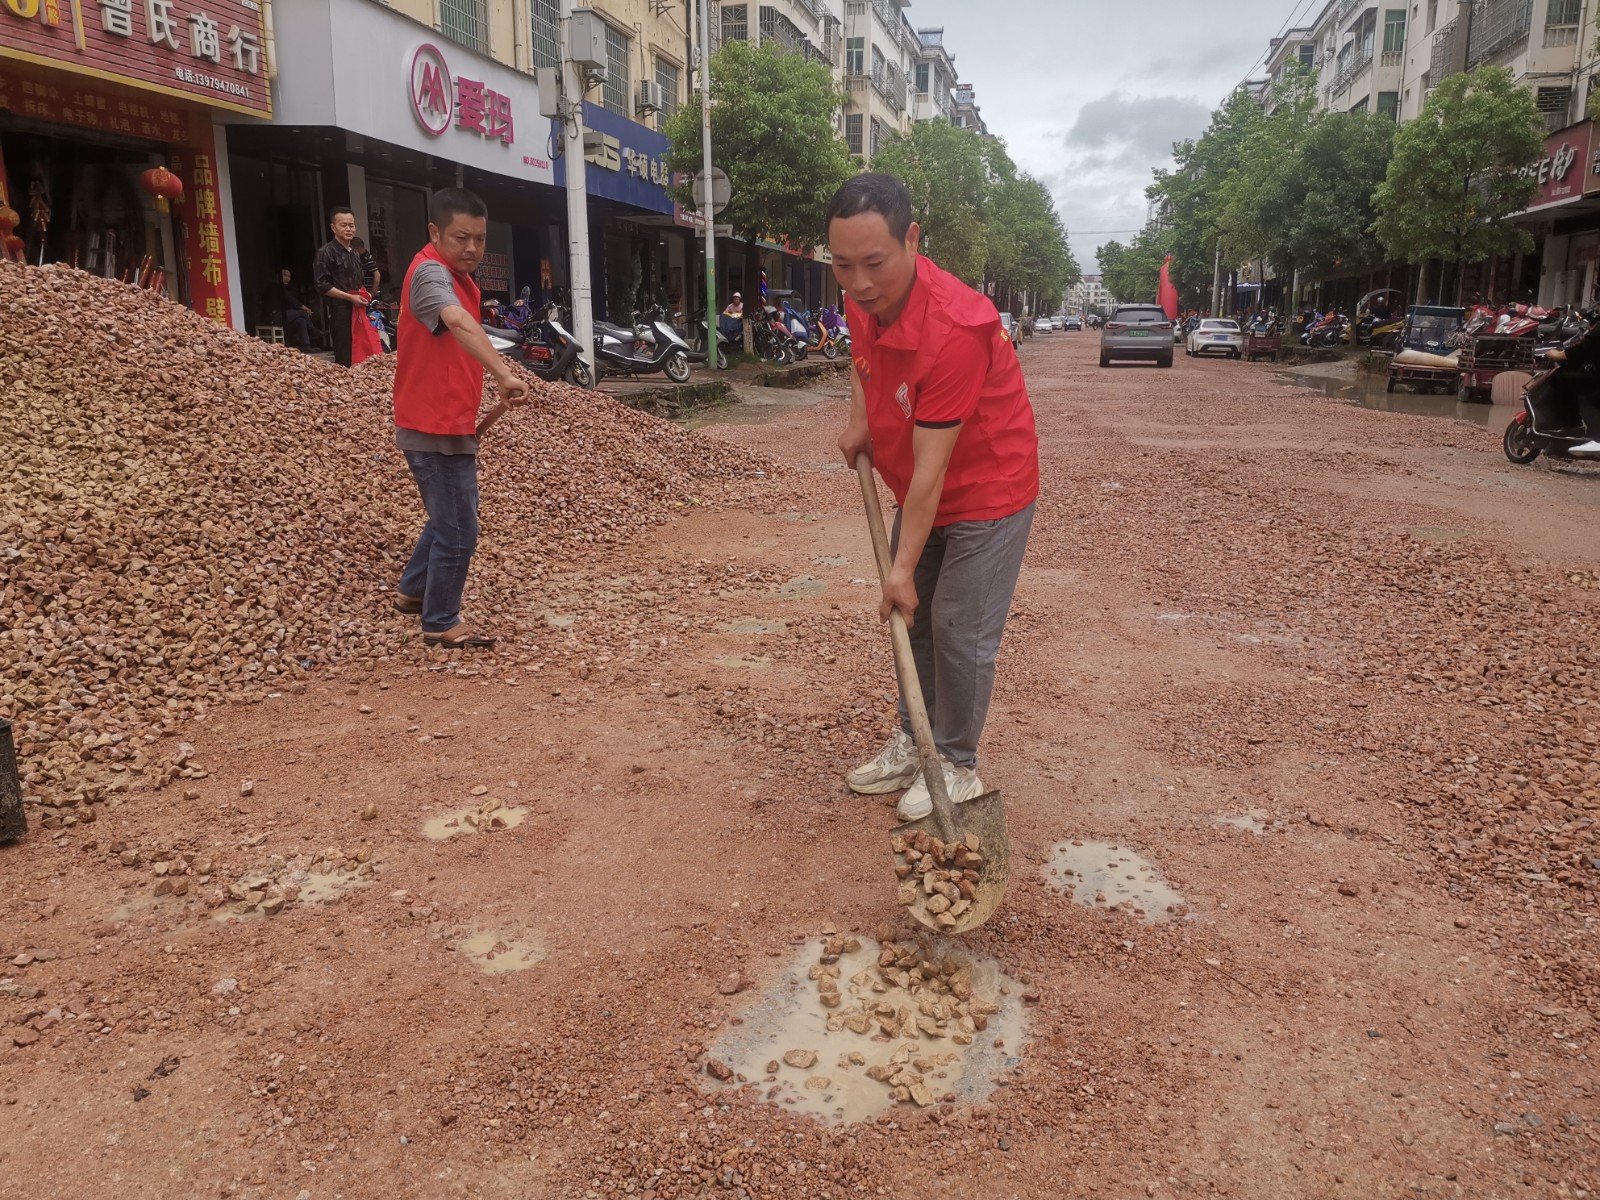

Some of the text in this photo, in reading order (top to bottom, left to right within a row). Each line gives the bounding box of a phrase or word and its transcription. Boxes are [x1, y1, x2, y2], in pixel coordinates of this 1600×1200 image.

[98, 0, 260, 74] 曾氏商行
[456, 75, 515, 145] 爱玛
[621, 147, 669, 187] 华硕电脑
[192, 154, 223, 287] 品牌墙布
